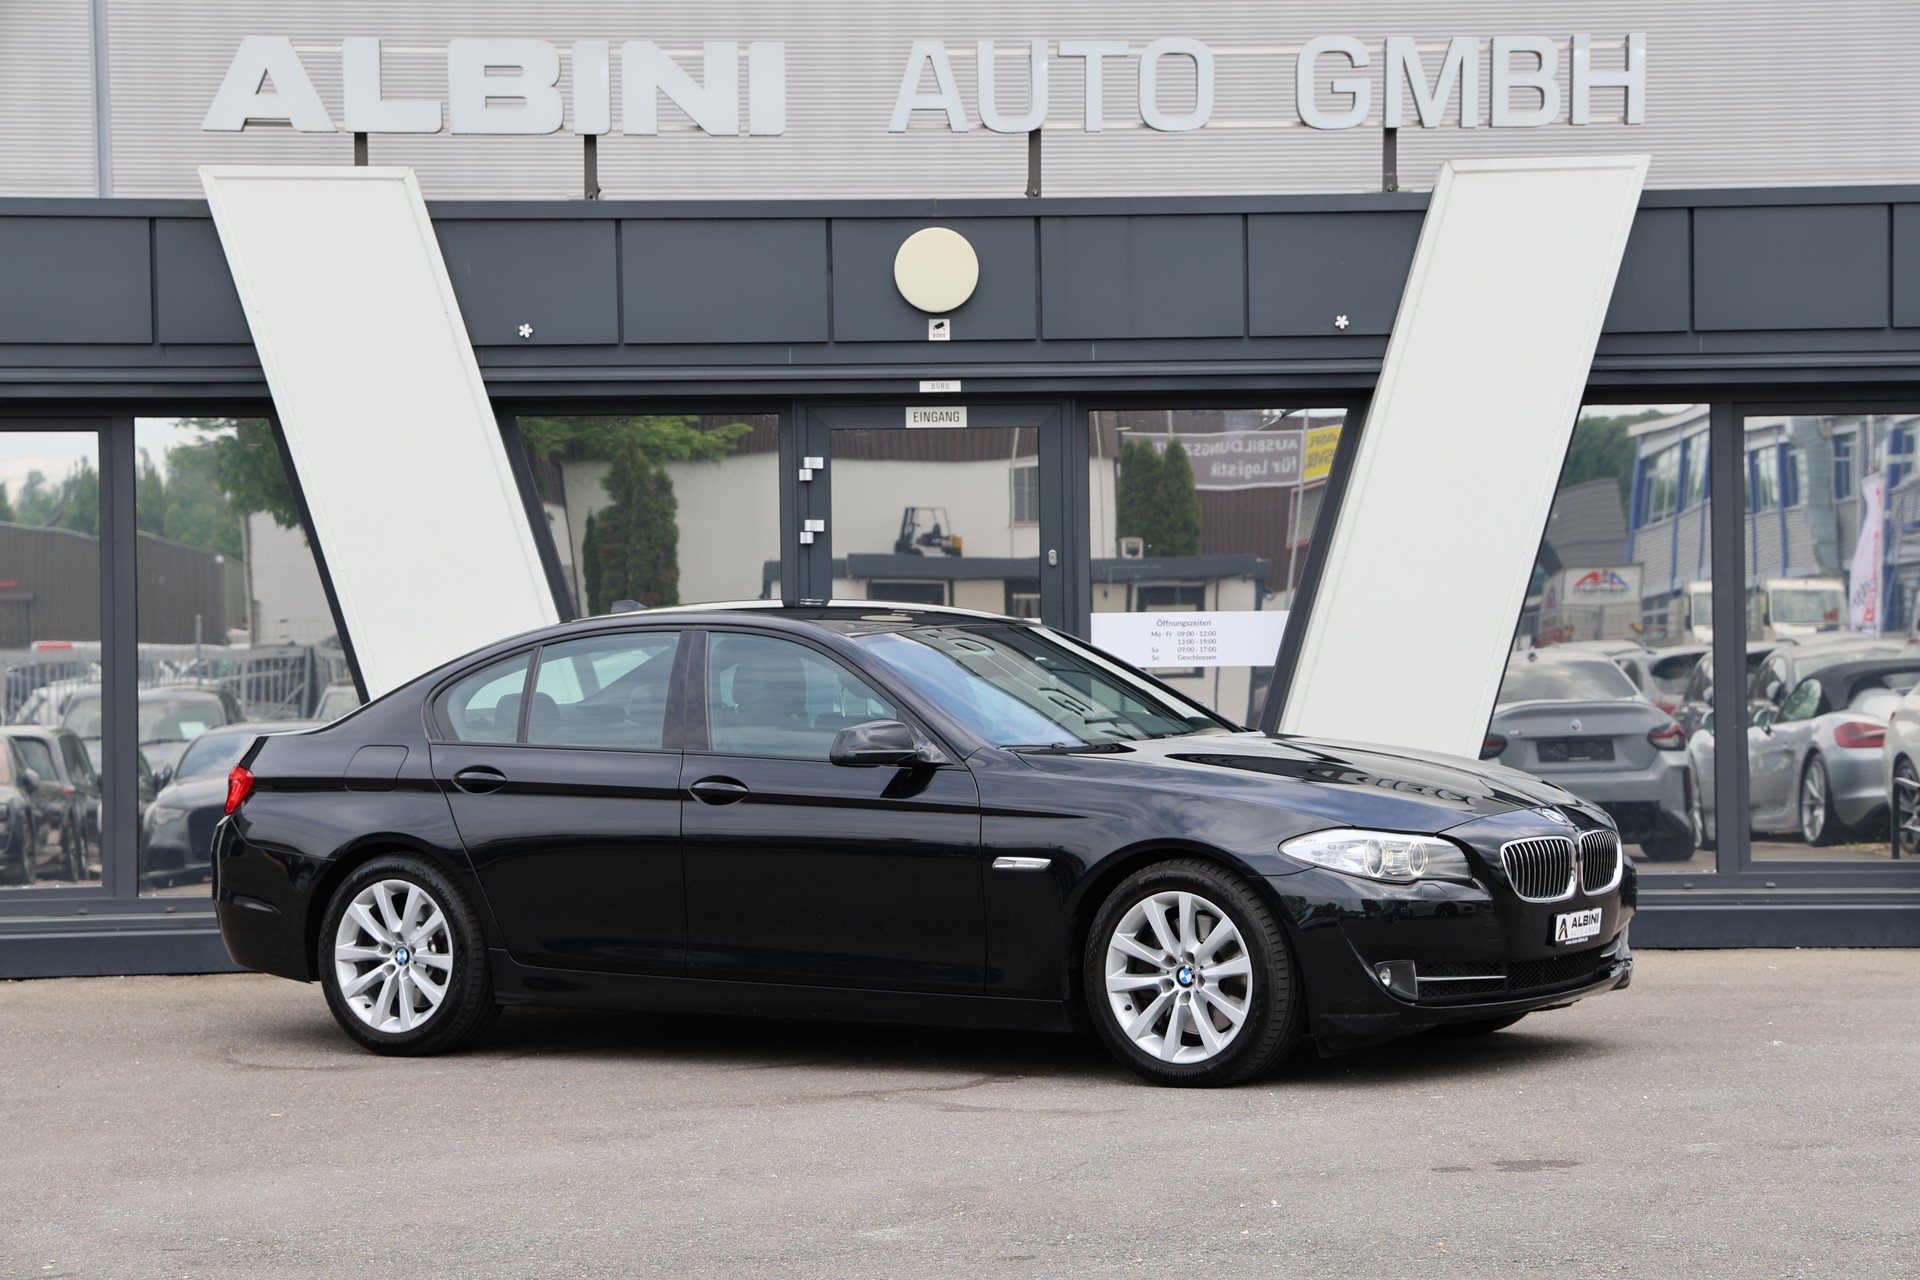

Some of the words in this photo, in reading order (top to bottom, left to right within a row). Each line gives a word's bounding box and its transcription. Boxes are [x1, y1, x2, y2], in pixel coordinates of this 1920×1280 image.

[202, 36, 786, 136] ALBINI
[888, 36, 1215, 134] AUTO
[1295, 32, 1646, 131] GMBH
[913, 411, 960, 423] EINGANG
[1156, 619, 1212, 628] Öffnungszeiten
[1571, 912, 1600, 929] ALBINI
